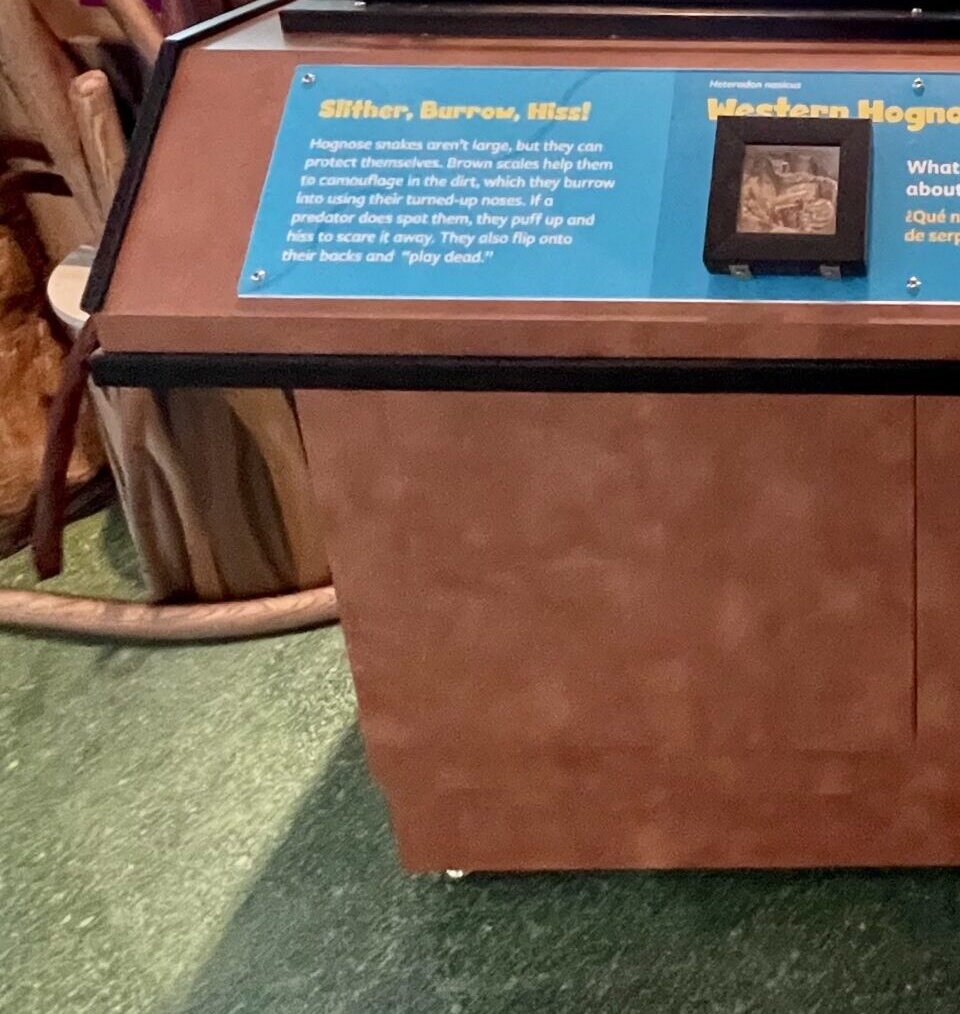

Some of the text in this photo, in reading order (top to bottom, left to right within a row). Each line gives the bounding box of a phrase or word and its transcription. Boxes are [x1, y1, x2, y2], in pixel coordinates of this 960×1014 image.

[319, 99, 591, 122] Slither, Burrow, Hiss!
[310, 138, 373, 153] Hognose
[375, 139, 423, 150] snakes
[472, 140, 512, 154] large,
[516, 140, 541, 152] but
[543, 140, 574, 155] they
[577, 143, 603, 152] can
[304, 156, 613, 173] protect themselves. Brown scales help them
[907, 160, 960, 174] What
[301, 174, 615, 191] to camouflage in the dirt, which they burrow
[296, 191, 553, 208] into using their turned-up noses. If a
[291, 211, 595, 228] predator does spot them, they puff up and
[905, 209, 947, 225] ¿Qué
[287, 230, 573, 247] hiss to scare it away. They also flip onto
[904, 228, 925, 242] de
[282, 249, 317, 261] their
[319, 249, 363, 262] backs
[366, 249, 395, 262] and
